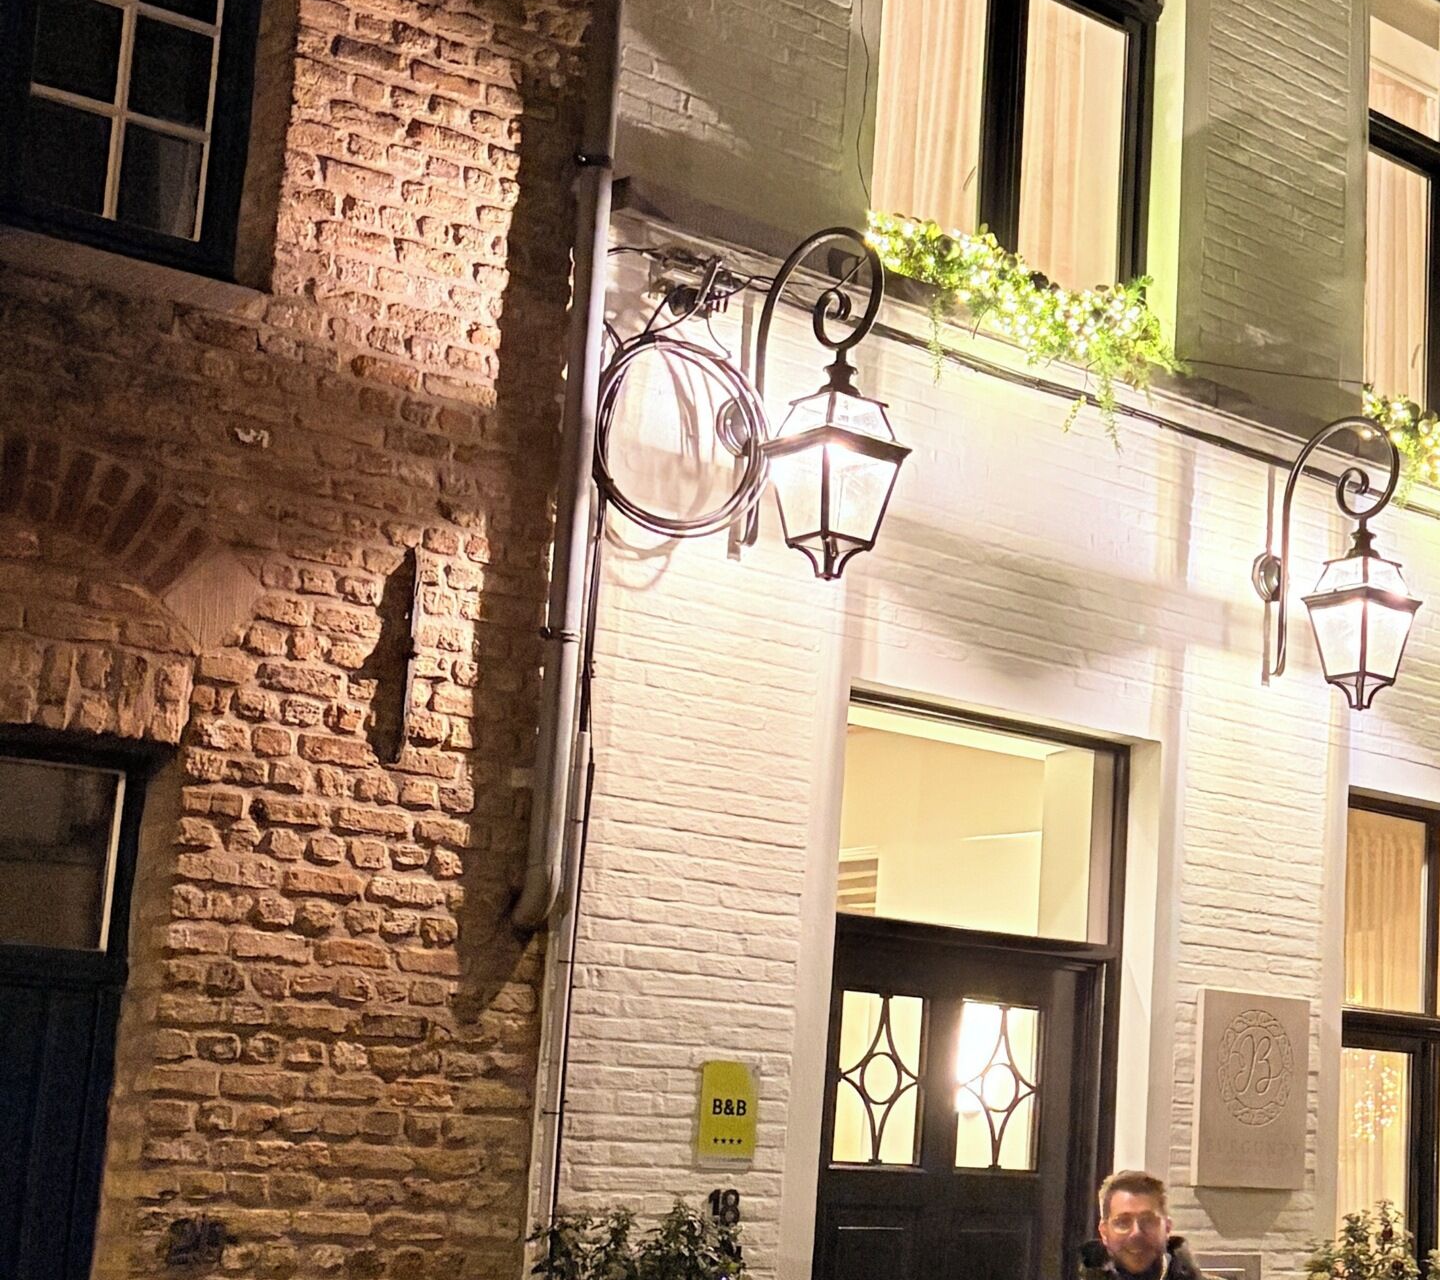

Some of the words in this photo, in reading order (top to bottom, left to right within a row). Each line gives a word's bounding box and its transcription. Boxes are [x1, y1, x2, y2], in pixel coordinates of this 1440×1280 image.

[712, 1098, 747, 1116] B&B
[1205, 1137, 1299, 1156] BURGUNDY
[708, 1189, 740, 1227] 18
